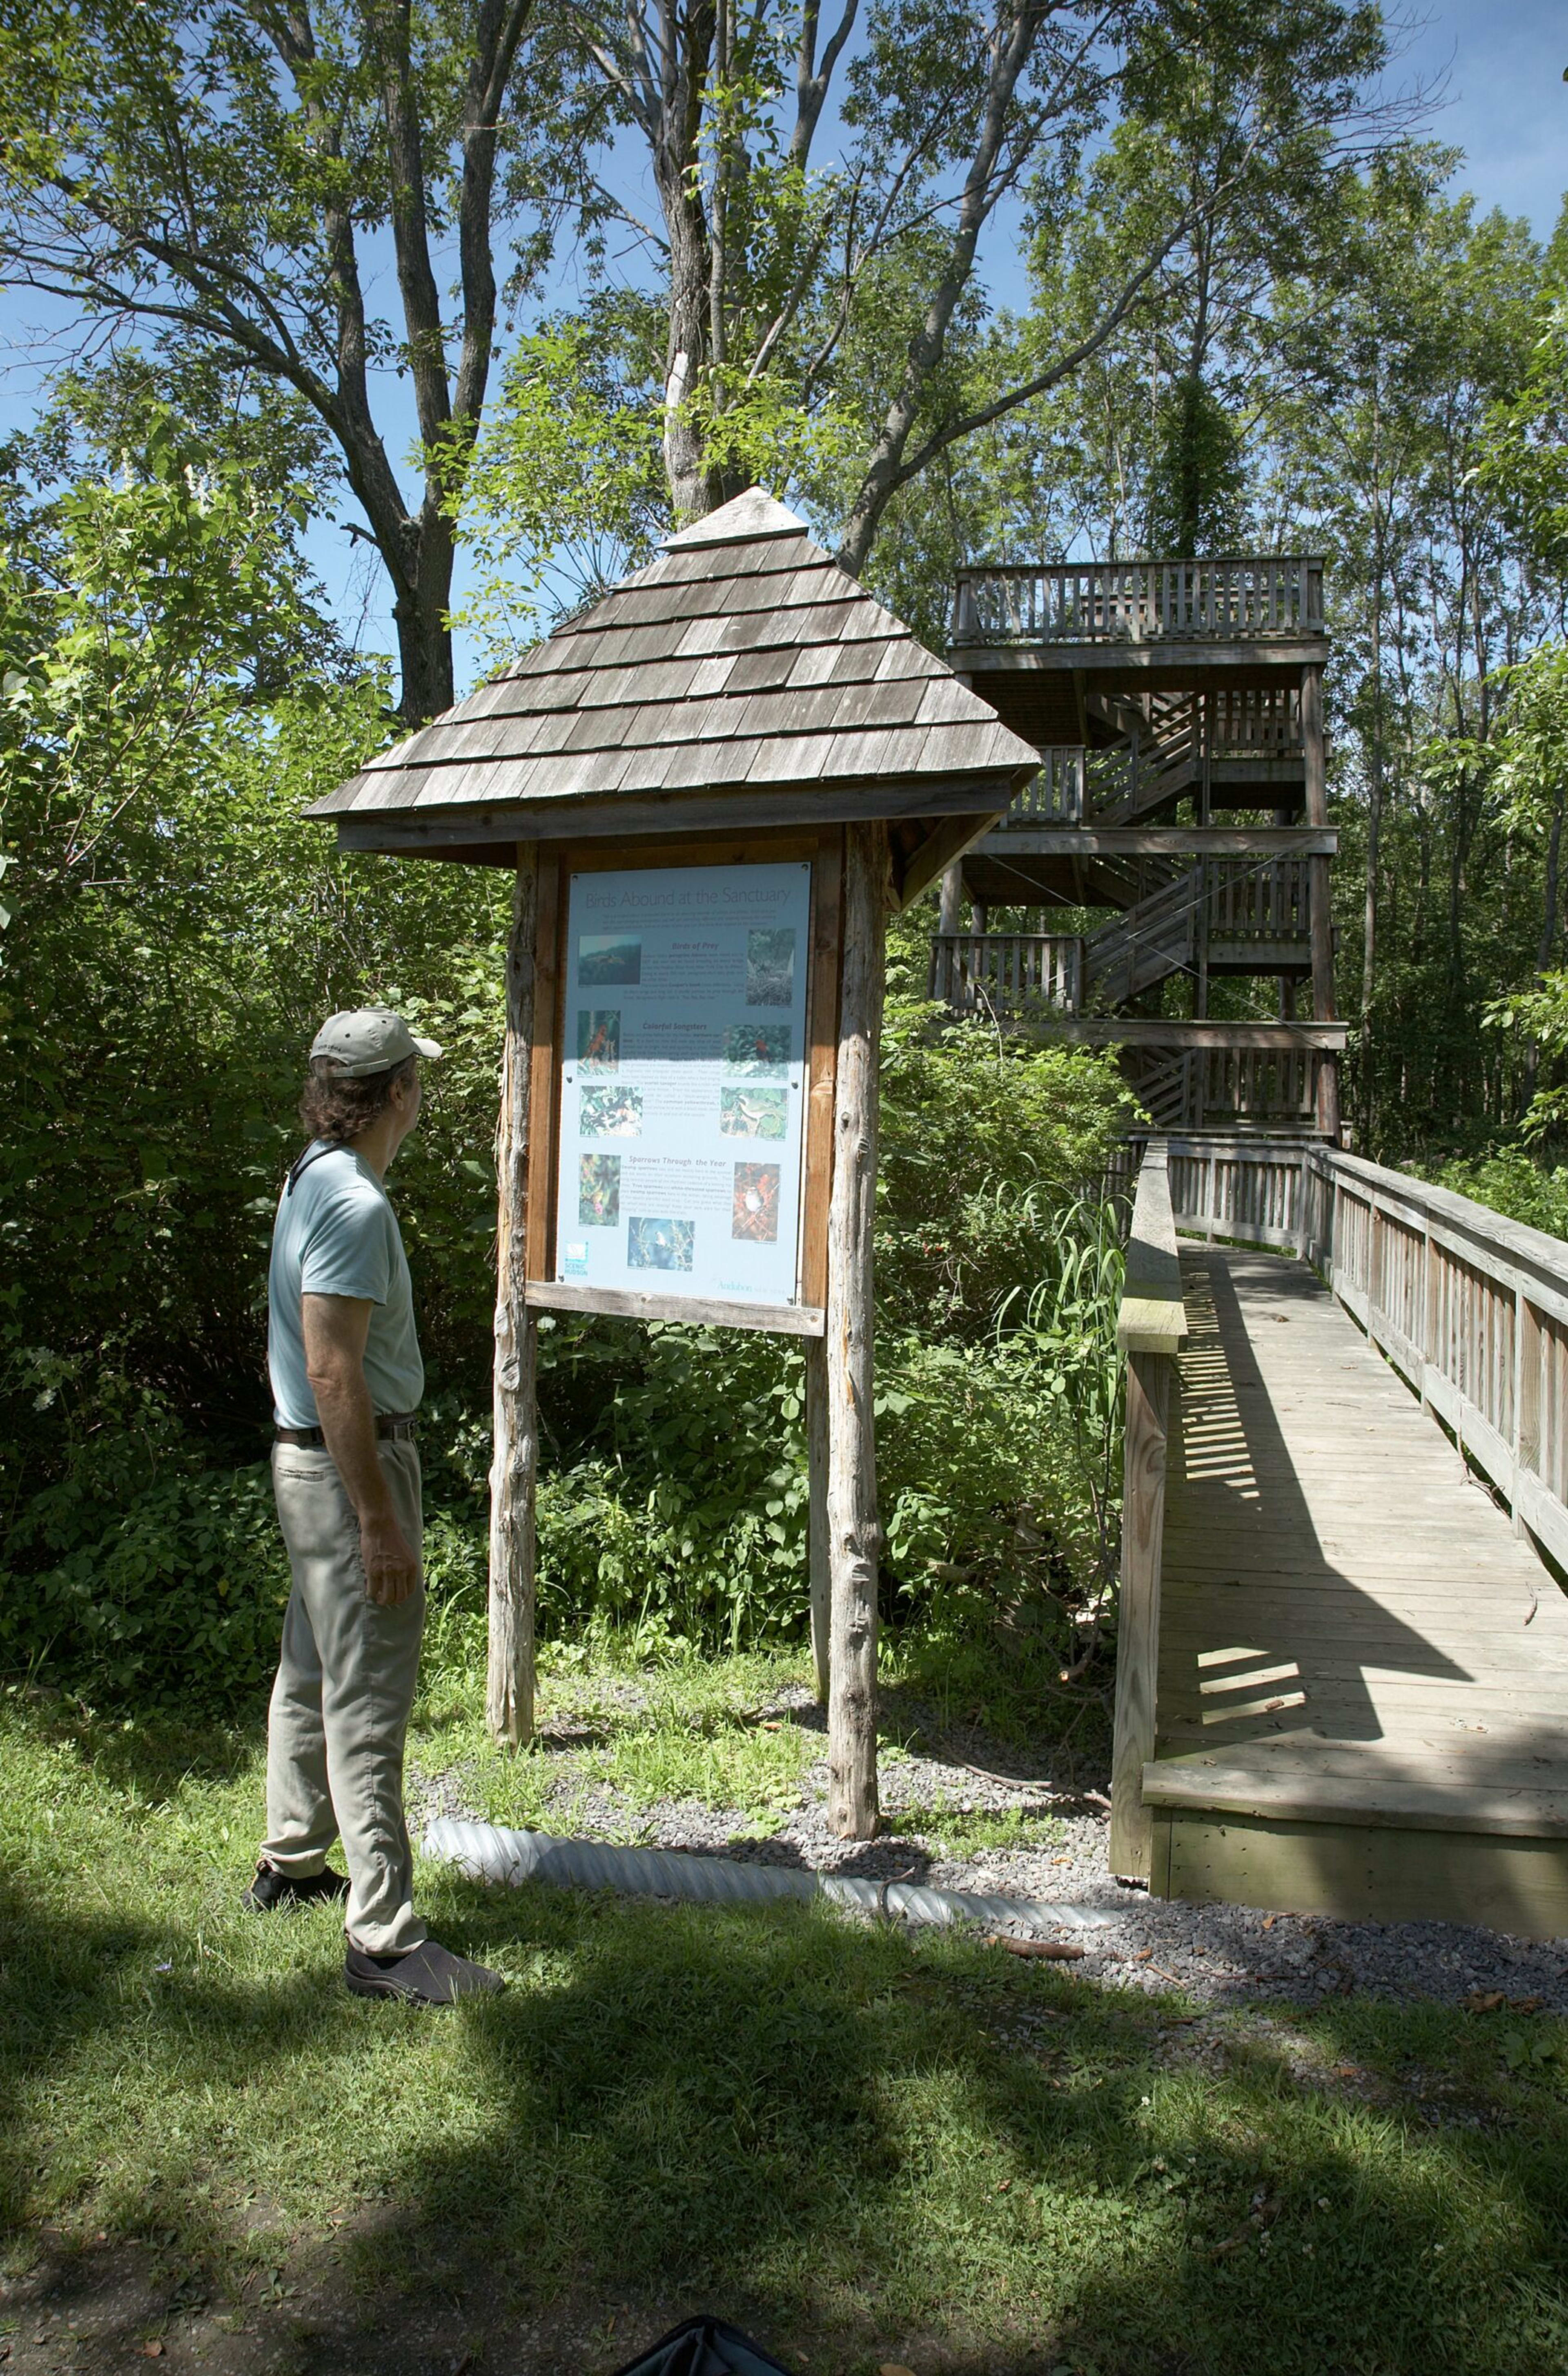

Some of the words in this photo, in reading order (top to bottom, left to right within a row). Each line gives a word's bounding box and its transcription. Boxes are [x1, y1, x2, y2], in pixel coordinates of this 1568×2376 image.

[586, 892, 617, 908] Birds
[619, 889, 675, 907] Abound
[678, 891, 691, 904] at
[696, 888, 718, 904] the
[722, 886, 791, 906] Sanctuary
[692, 942, 701, 951] of
[702, 942, 719, 951] Prey
[643, 1022, 672, 1031] Colorful
[673, 1023, 707, 1031] Songsters
[629, 1156, 660, 1164] Sparrows
[663, 1157, 692, 1167] Through
